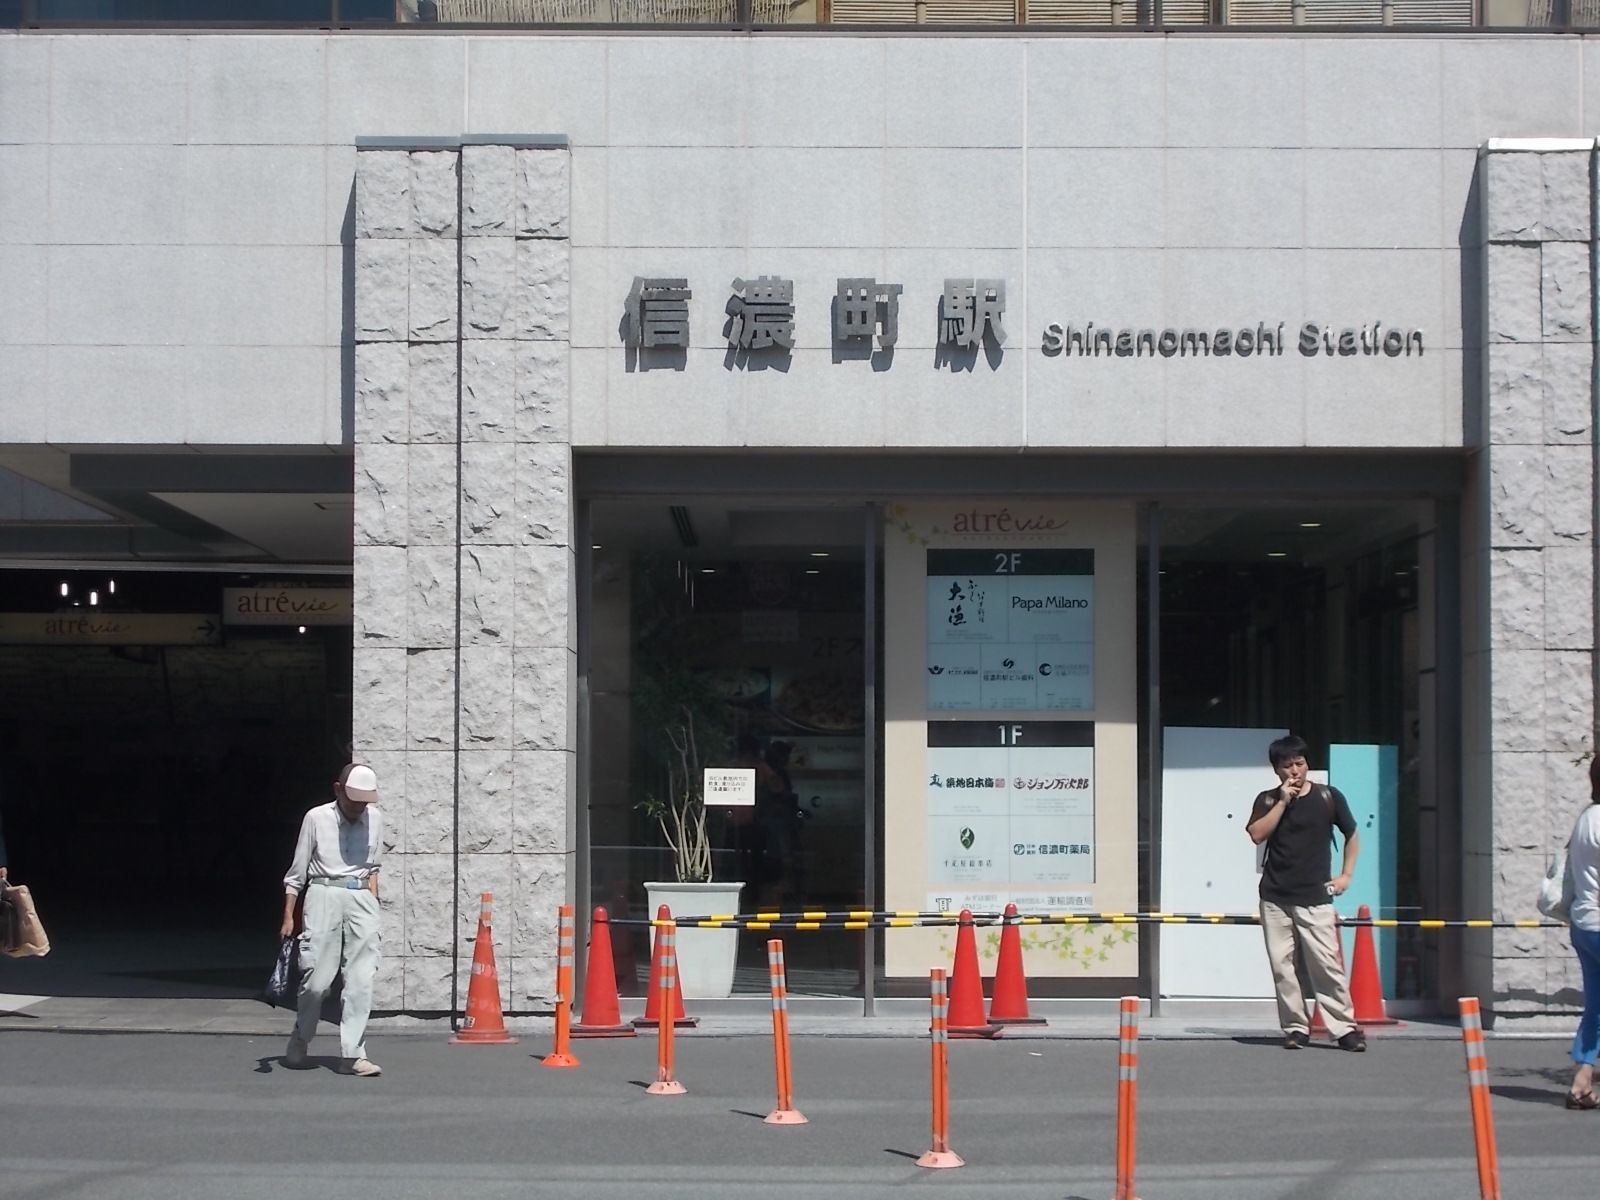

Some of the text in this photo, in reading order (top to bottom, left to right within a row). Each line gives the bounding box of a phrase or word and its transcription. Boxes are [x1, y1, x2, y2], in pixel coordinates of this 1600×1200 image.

[621, 276, 1007, 350] 信濃町駅
[1042, 321, 1424, 357] Shinanomachi Station
[994, 553, 1022, 573] 2F
[1012, 596, 1089, 612] Papa Milano
[998, 725, 1023, 745] 1F
[1027, 778, 1090, 789] ジョン万次郎
[1039, 844, 1091, 855] 信濃町薬局
